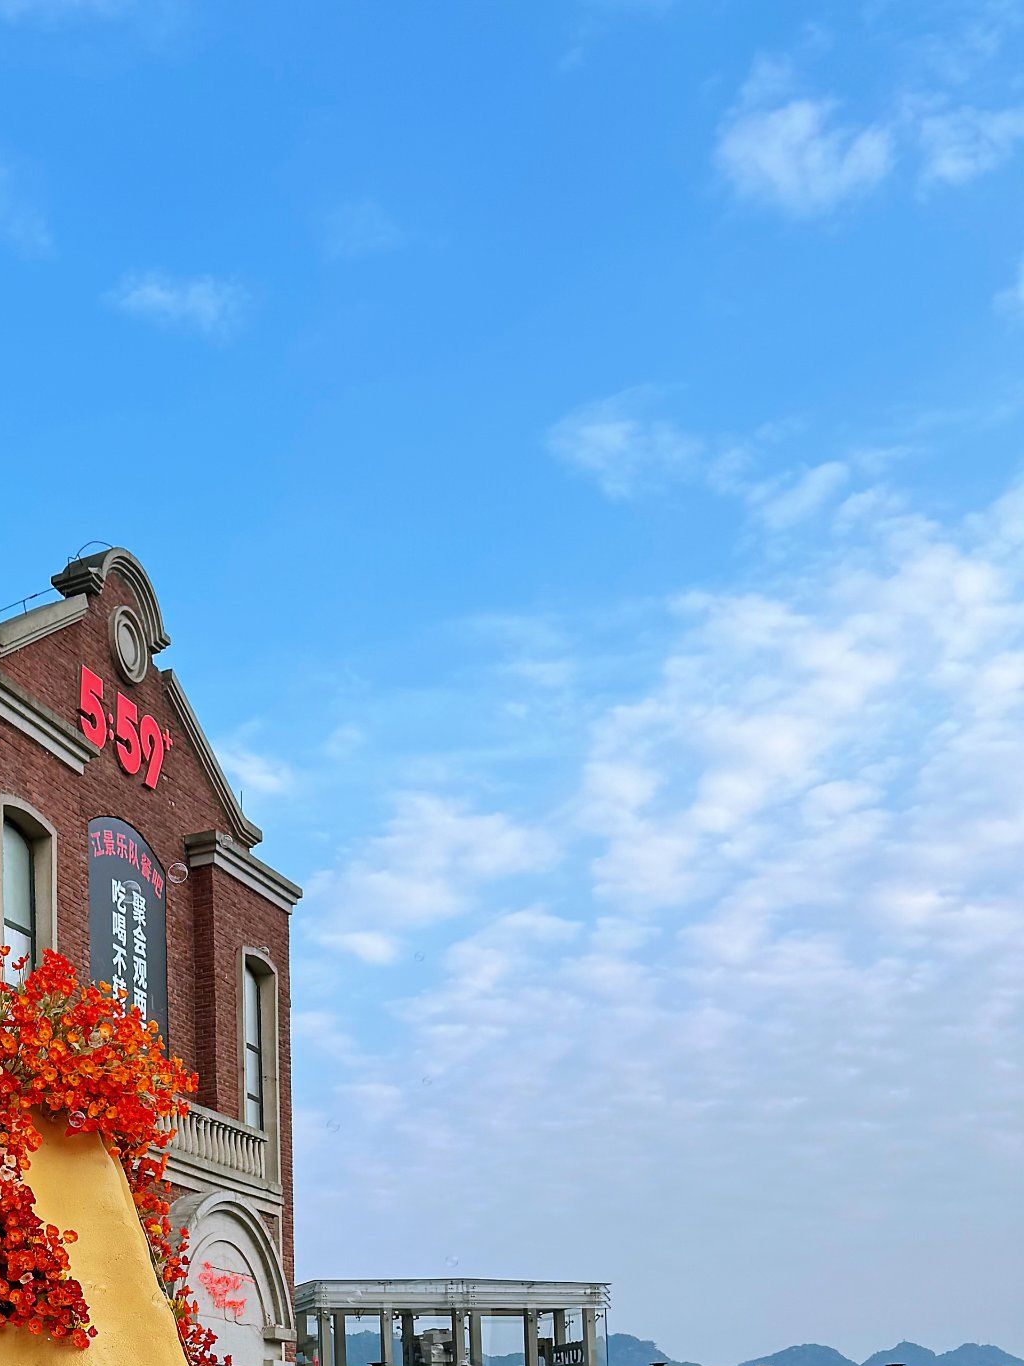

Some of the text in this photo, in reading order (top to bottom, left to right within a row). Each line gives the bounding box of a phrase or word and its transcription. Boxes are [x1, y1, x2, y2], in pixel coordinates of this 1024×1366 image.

[91, 829, 164, 900] 江景乐队餐吧
[132, 890, 148, 1031] 聚会观两
